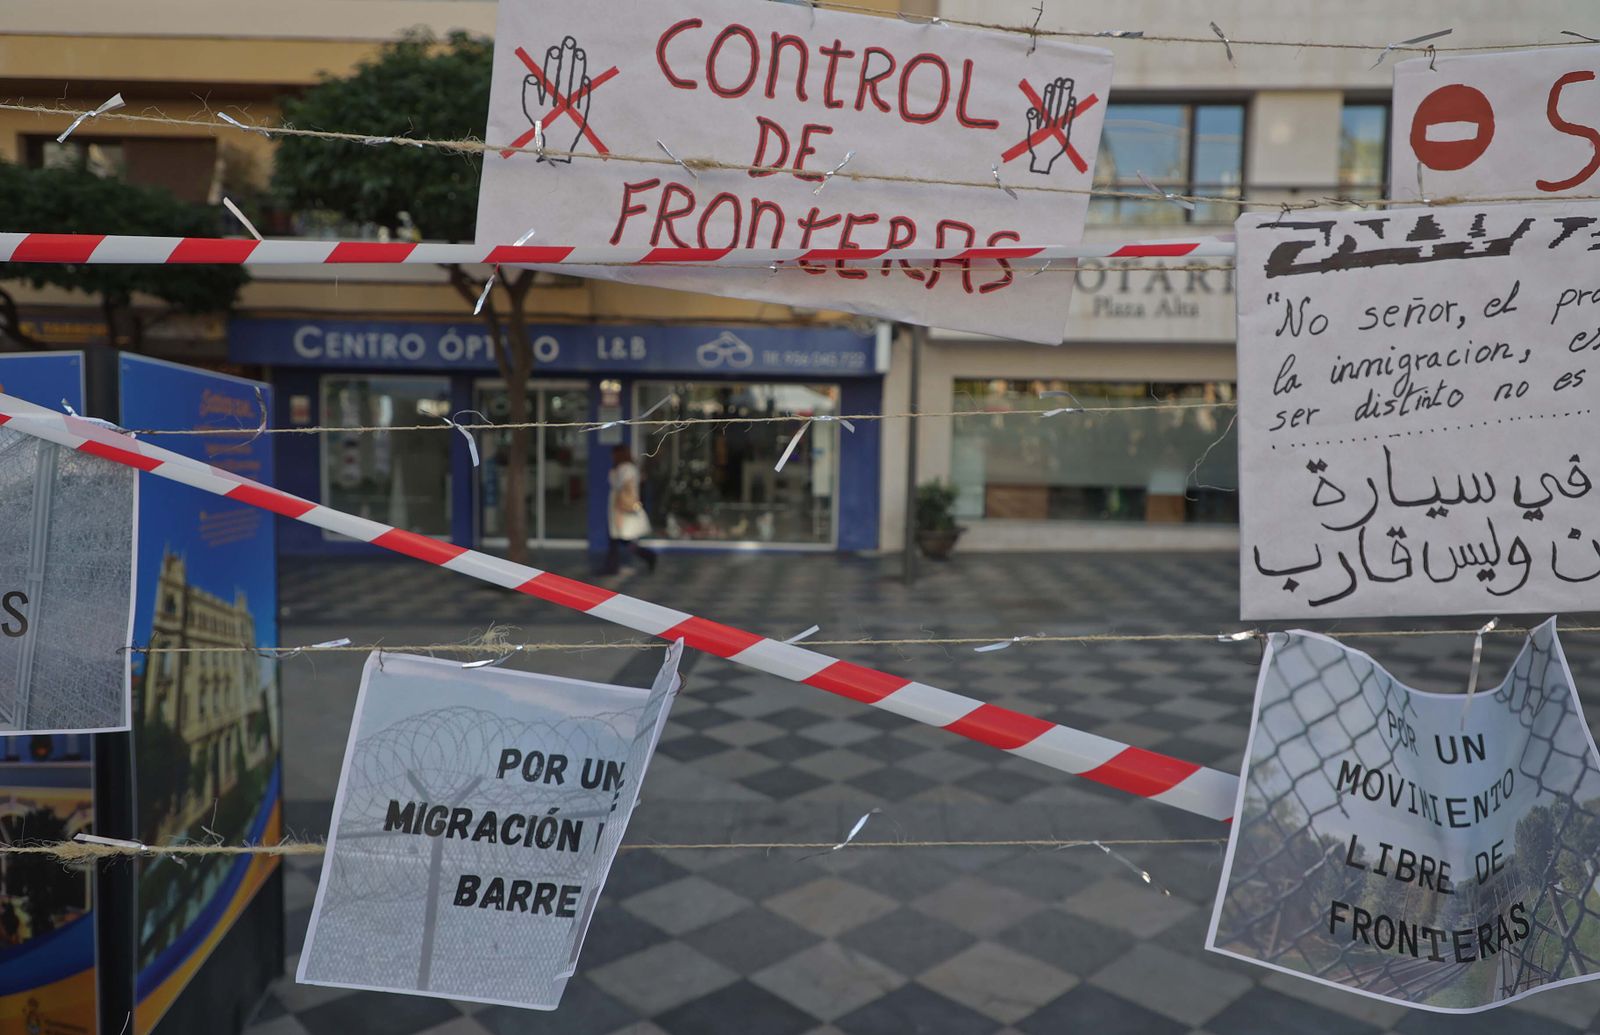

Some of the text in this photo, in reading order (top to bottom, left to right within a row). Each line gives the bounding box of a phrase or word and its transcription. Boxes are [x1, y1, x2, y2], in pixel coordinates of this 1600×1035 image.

[748, 116, 833, 182] DE
[1358, 297, 1467, 331] señor,
[1483, 279, 1521, 318] el
[292, 324, 426, 360] CENTRO
[597, 335, 647, 360] L&B
[1268, 368, 1587, 432] ser distinto no es
[1272, 353, 1303, 396] la
[1305, 444, 1593, 532] في سيارة
[0, 590, 29, 638] S
[1386, 708, 1486, 765] POR UN
[495, 748, 568, 786] POR
[1336, 759, 1514, 829] MOVIMIENTO
[383, 799, 584, 853] MIGRACIÓN
[1345, 833, 1505, 896] LIBRE DE
[453, 873, 582, 918] BARRE
[1329, 900, 1531, 964] FRONTERAS
